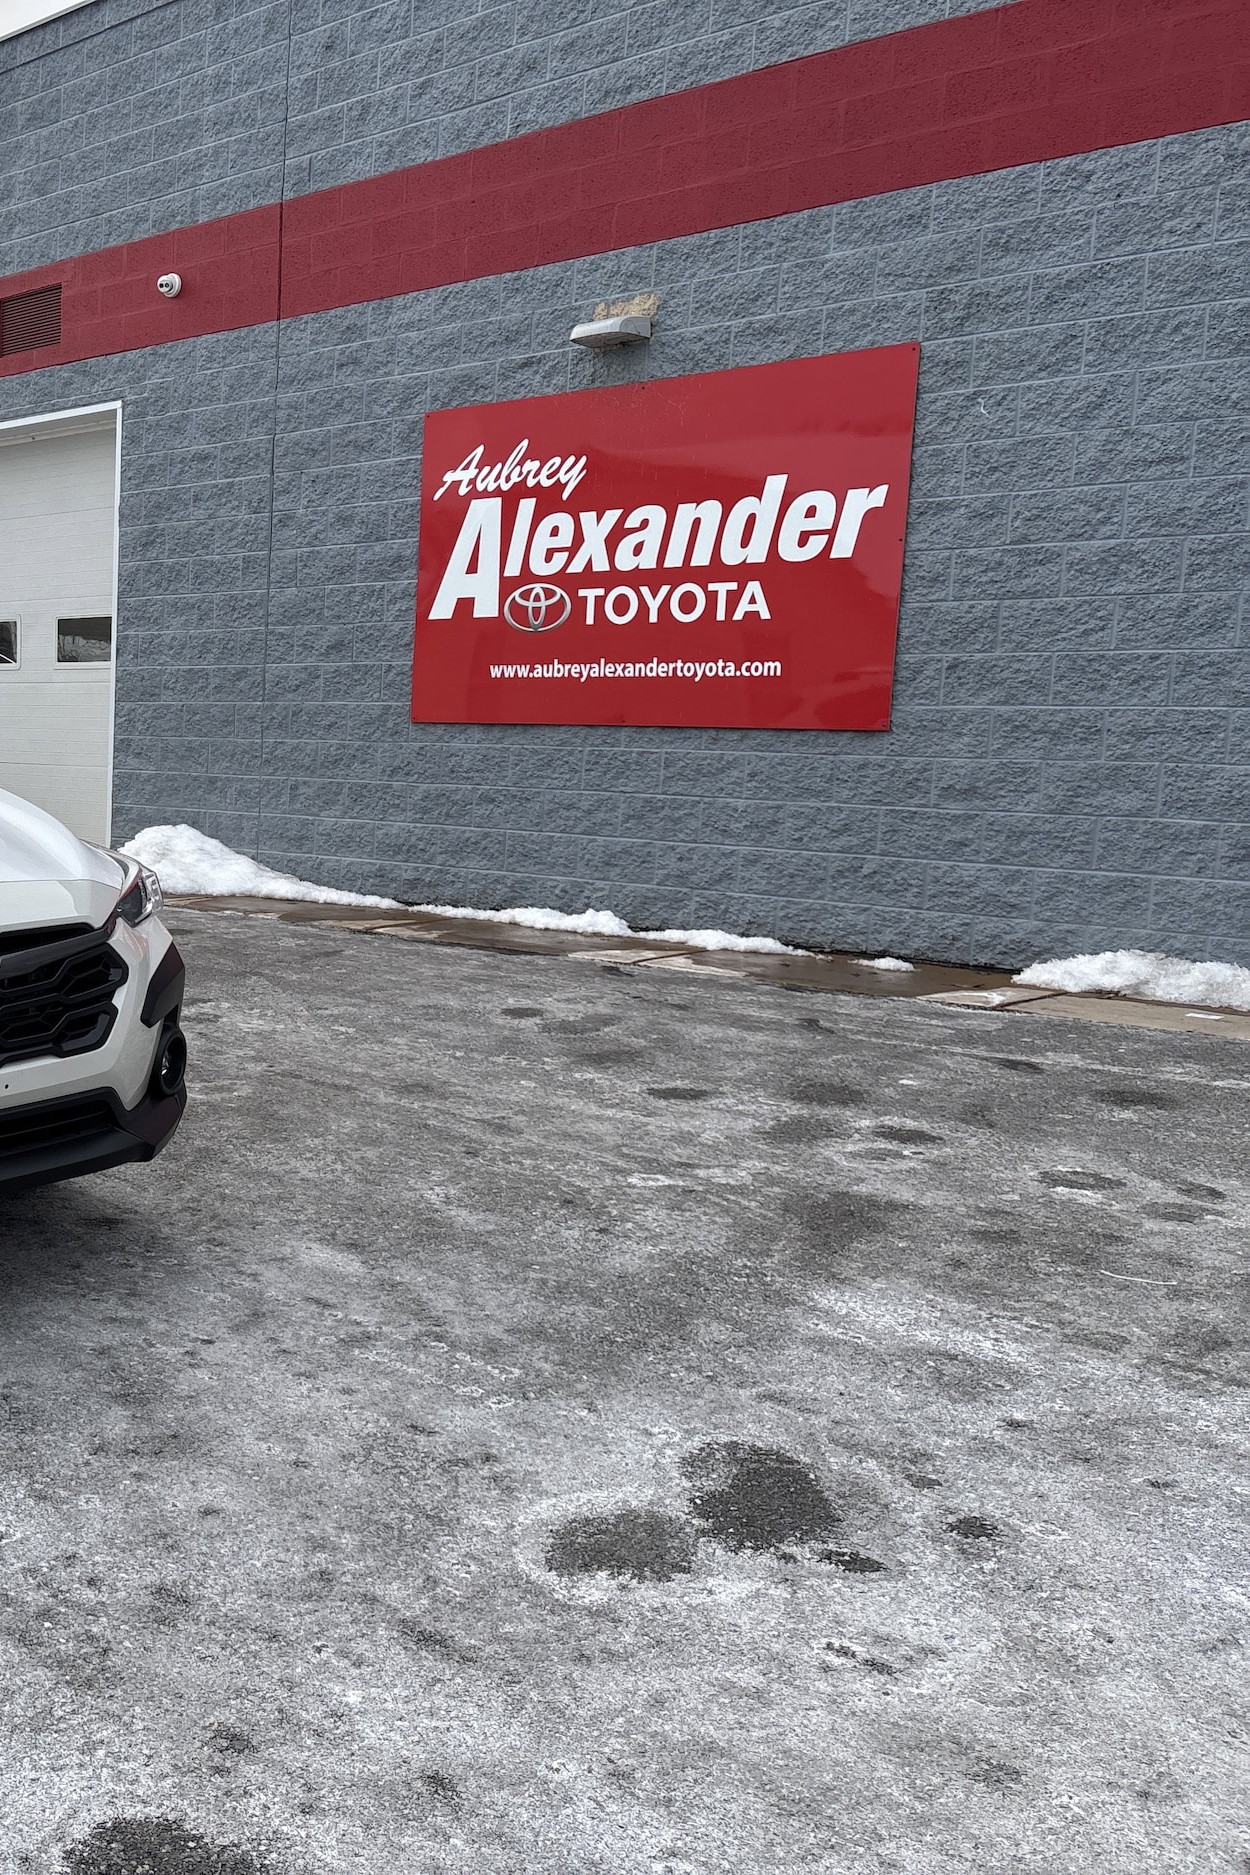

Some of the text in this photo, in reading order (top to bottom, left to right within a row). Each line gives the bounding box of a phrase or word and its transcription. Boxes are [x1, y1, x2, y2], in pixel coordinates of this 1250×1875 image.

[434, 438, 587, 501] Aubrey
[427, 473, 890, 620] Alexander
[578, 580, 772, 625] TOYOTA
[489, 657, 782, 683] www.aubreyalexandertoyota.com
